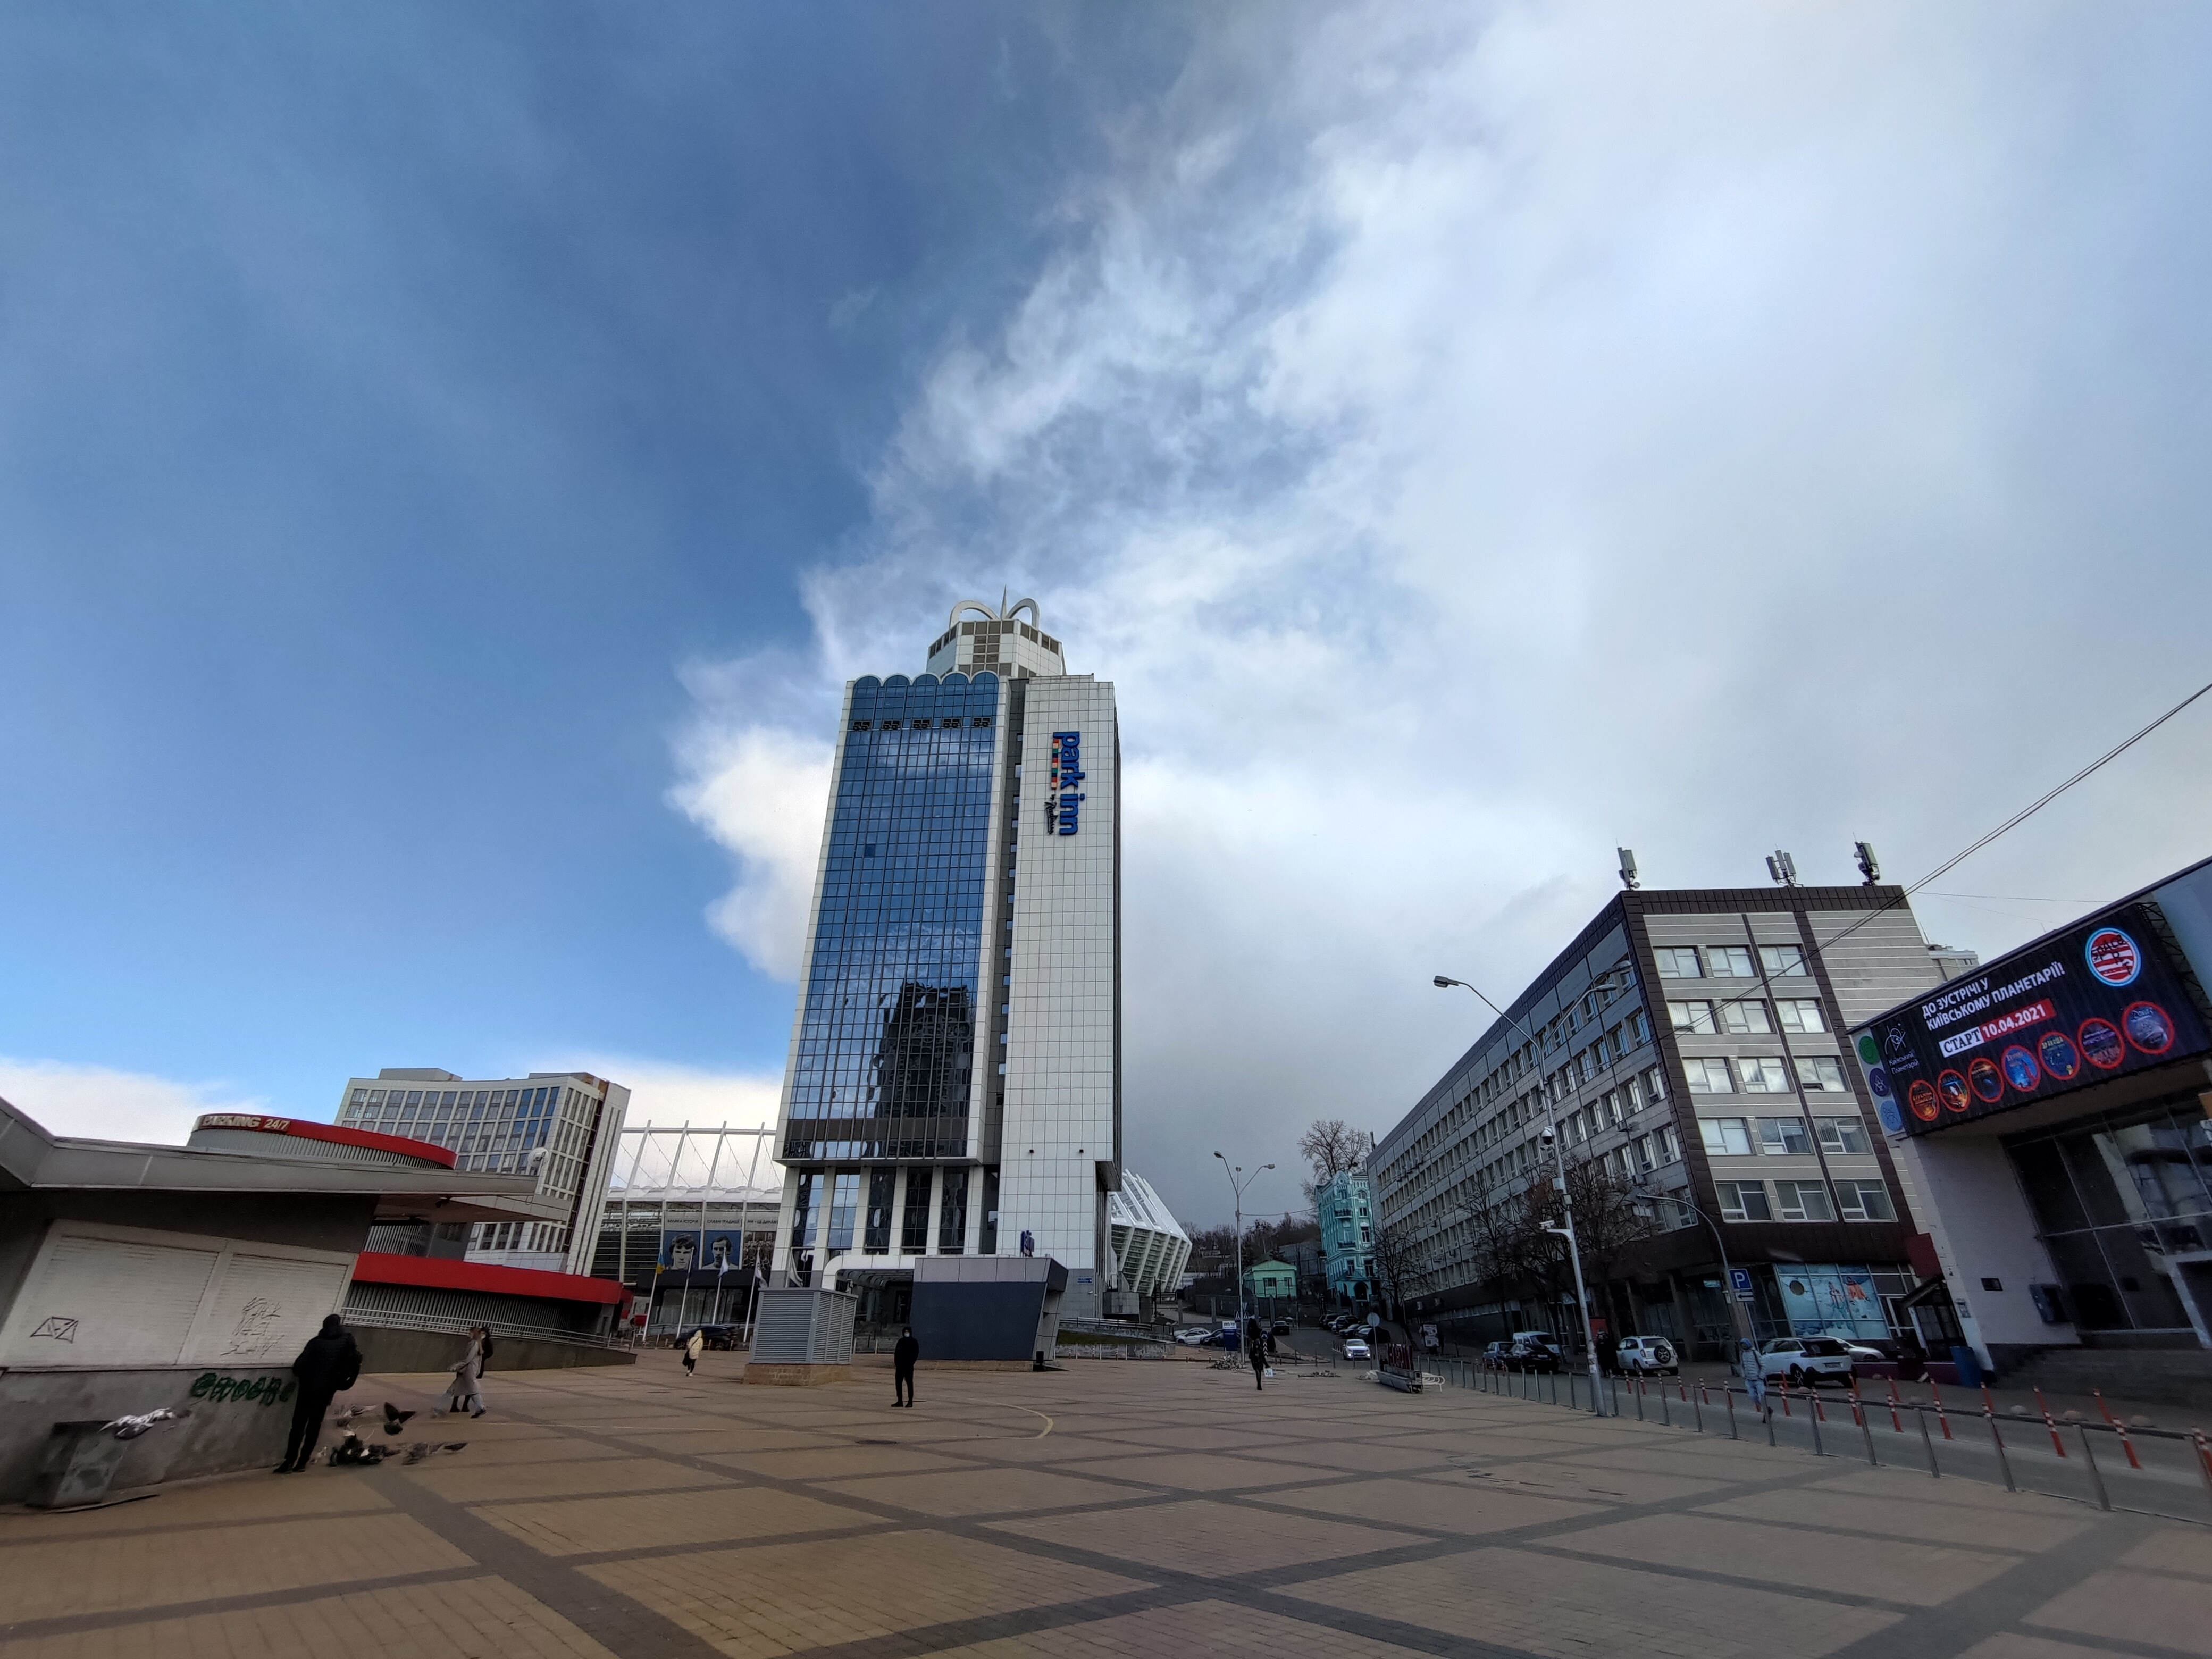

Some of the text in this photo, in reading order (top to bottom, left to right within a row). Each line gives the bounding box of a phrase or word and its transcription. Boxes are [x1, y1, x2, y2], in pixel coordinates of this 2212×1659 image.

[1052, 731, 1085, 836] park inn
[1921, 977, 1989, 1019] ДО ЗУСТРІЧІ У
[1926, 994, 1990, 1031] КИЇВСЬКОМУ
[1992, 961, 2066, 1003] ПЛАНЕТАРІЇ!
[1943, 1004, 2046, 1053] СТАРТ 10.04.2021
[264, 1118, 290, 1130] 24/7
[1733, 1272, 1745, 1288] P
